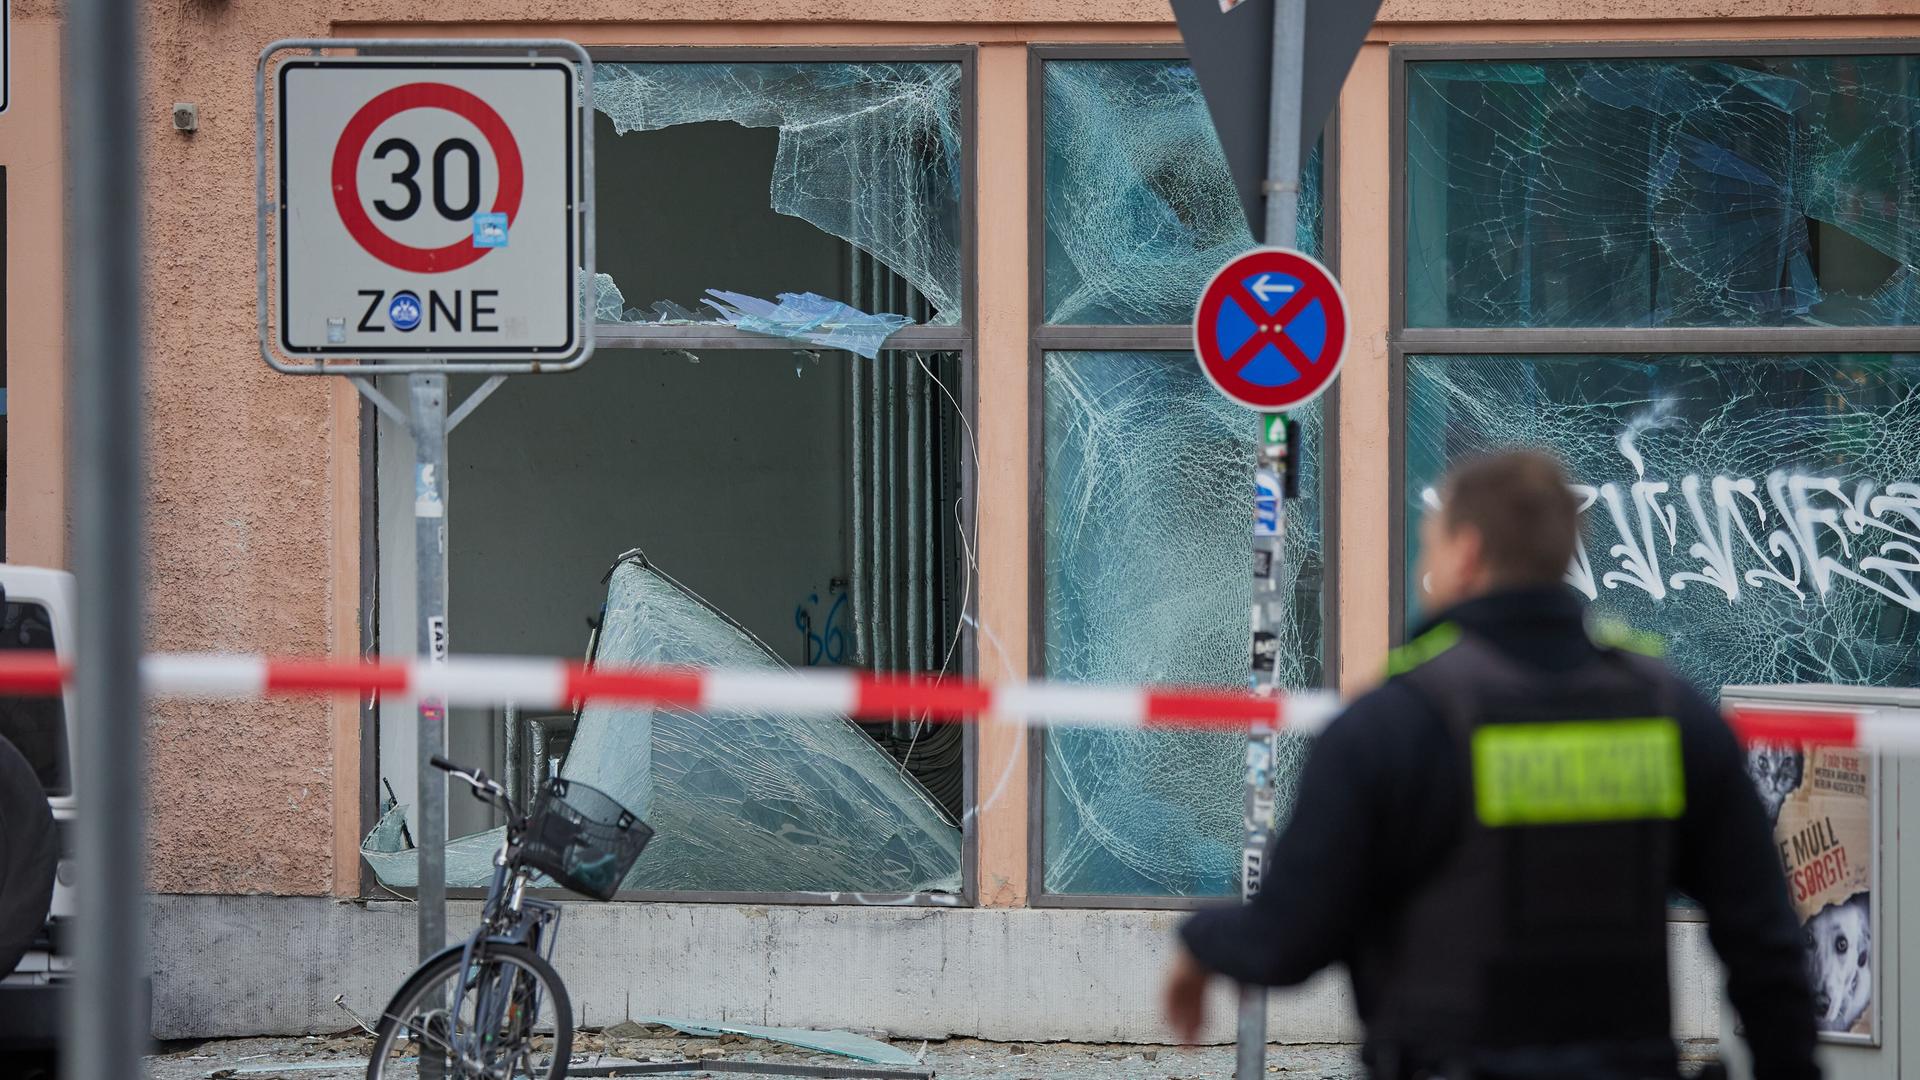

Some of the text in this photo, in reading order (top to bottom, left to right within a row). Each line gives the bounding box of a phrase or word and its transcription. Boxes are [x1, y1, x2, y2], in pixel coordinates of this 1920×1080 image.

[373, 138, 480, 221] 30
[357, 289, 498, 333] ZNE
[1791, 816, 1840, 866] MÜLL
